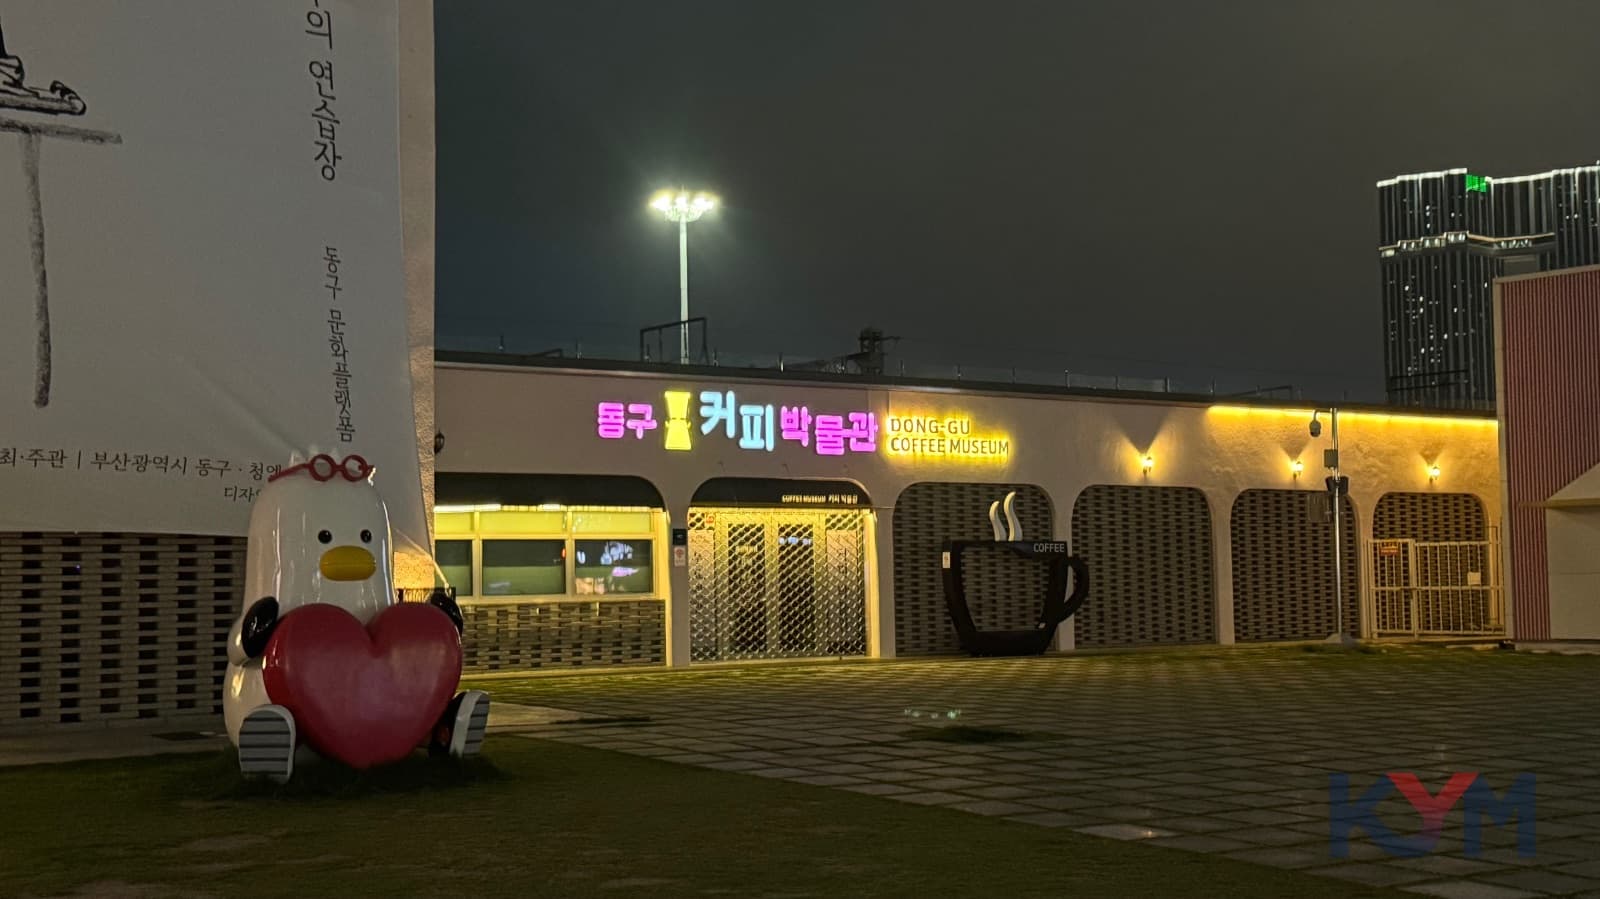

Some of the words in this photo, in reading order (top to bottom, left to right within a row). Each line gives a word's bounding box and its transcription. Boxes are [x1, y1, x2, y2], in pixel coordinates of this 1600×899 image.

[305, 0, 333, 50] 의
[308, 60, 343, 182] 연습장
[322, 245, 343, 301] 동구
[327, 308, 356, 443] 문화플랫폼
[598, 402, 658, 440] 동구
[699, 389, 775, 452] 커피
[780, 405, 878, 455] 박물관
[890, 418, 970, 435] DONG-GU
[890, 436, 945, 453] COFFEE
[949, 438, 1009, 455] MUSEUM
[90, 451, 188, 474] 부산광역시
[195, 457, 232, 478] 동구
[1033, 542, 1065, 553] COFFEE
